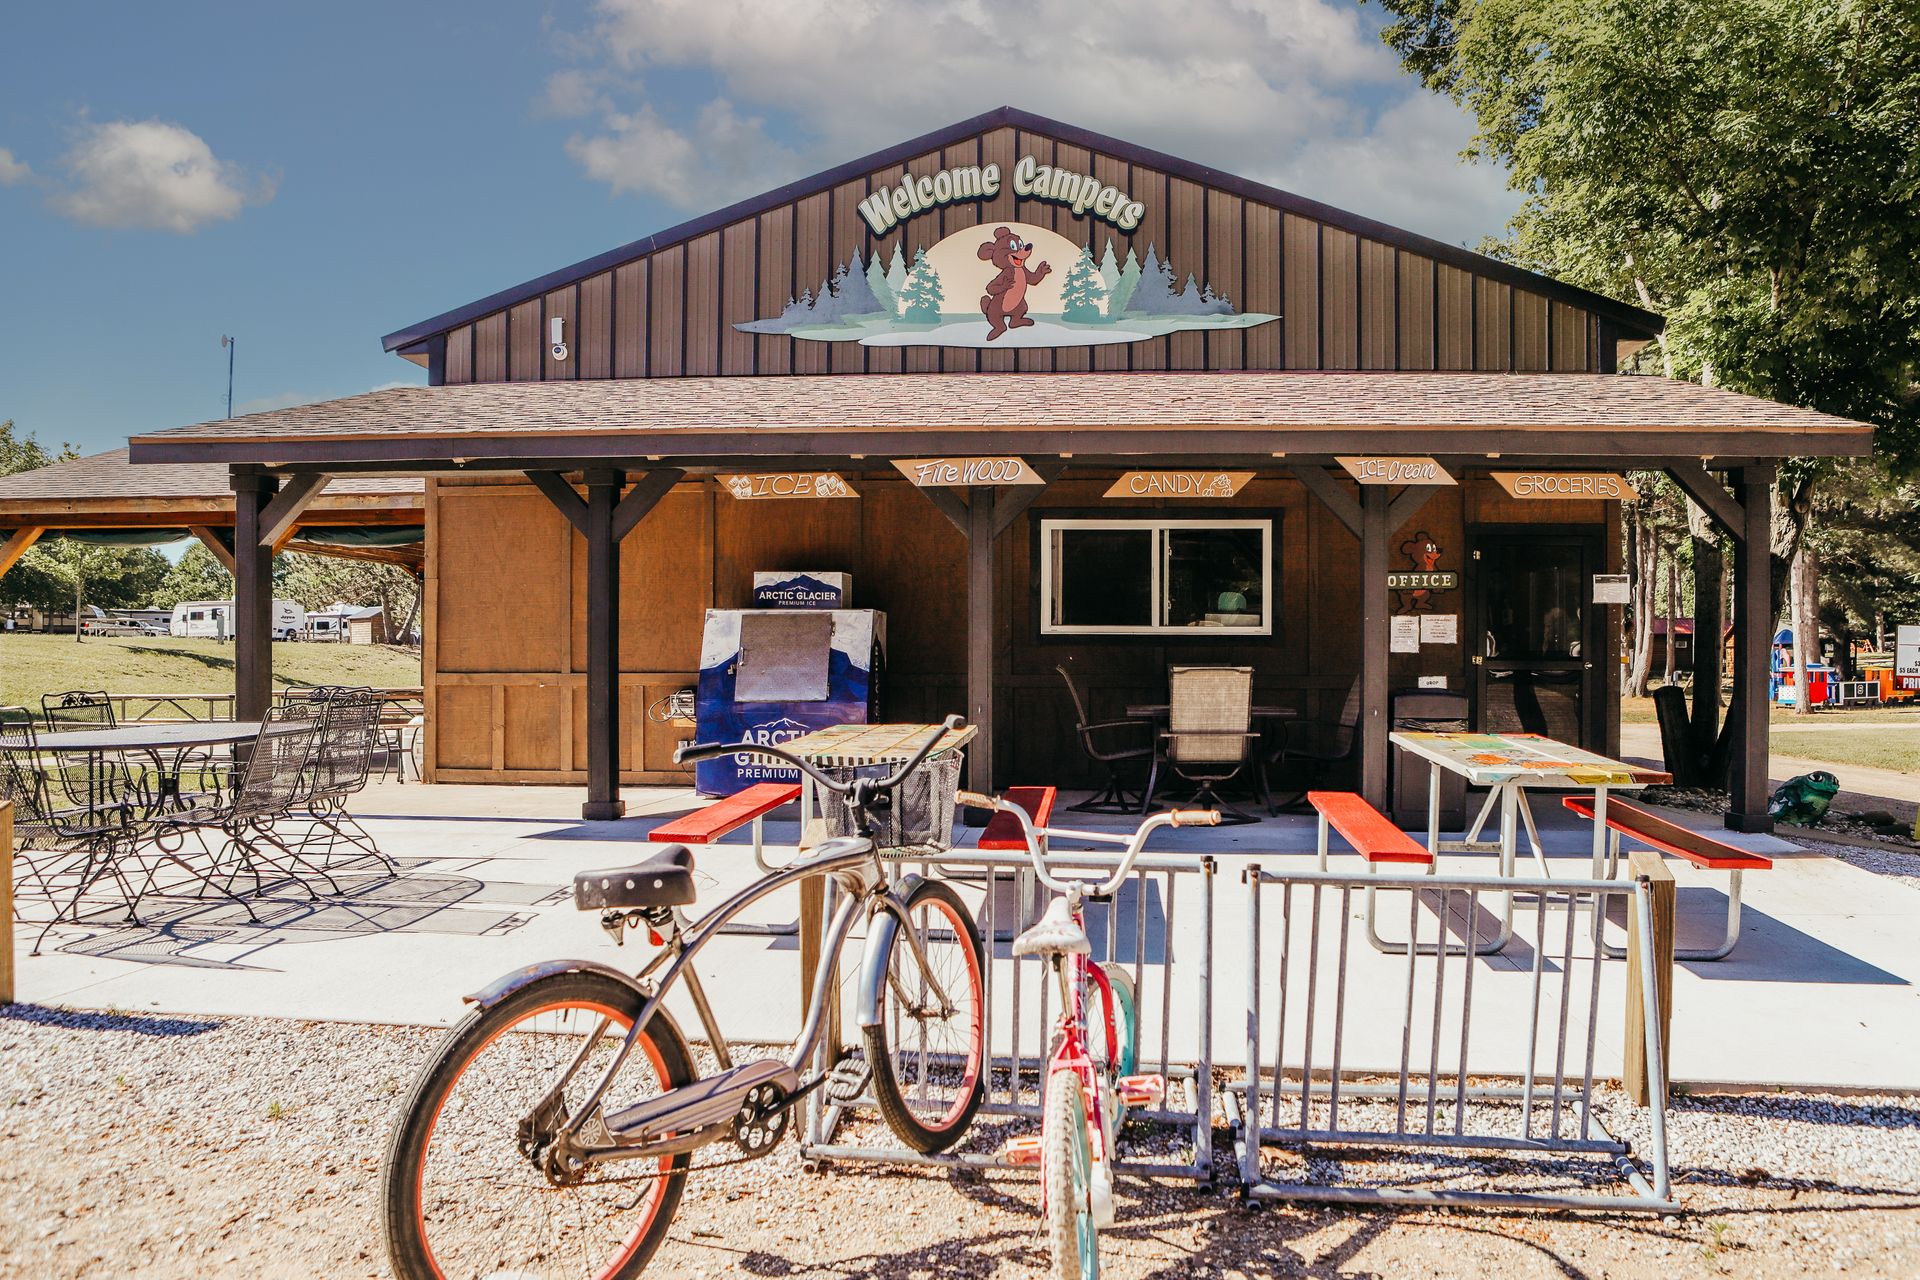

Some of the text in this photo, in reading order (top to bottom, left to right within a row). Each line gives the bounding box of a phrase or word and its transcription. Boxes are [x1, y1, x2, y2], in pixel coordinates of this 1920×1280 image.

[858, 154, 1145, 235] Welcome Campers
[915, 459, 1022, 486] Fire WOOD
[1356, 459, 1438, 481] ICE Cream
[752, 474, 814, 496] ICE
[1129, 474, 1204, 495] CANDY
[1513, 474, 1620, 497] GROCERIES
[1387, 574, 1452, 587] OFFICE
[758, 591, 836, 601] ARCTIC GLACIER
[741, 729, 816, 747] ARCTI
[737, 768, 798, 778] PREMIUM
